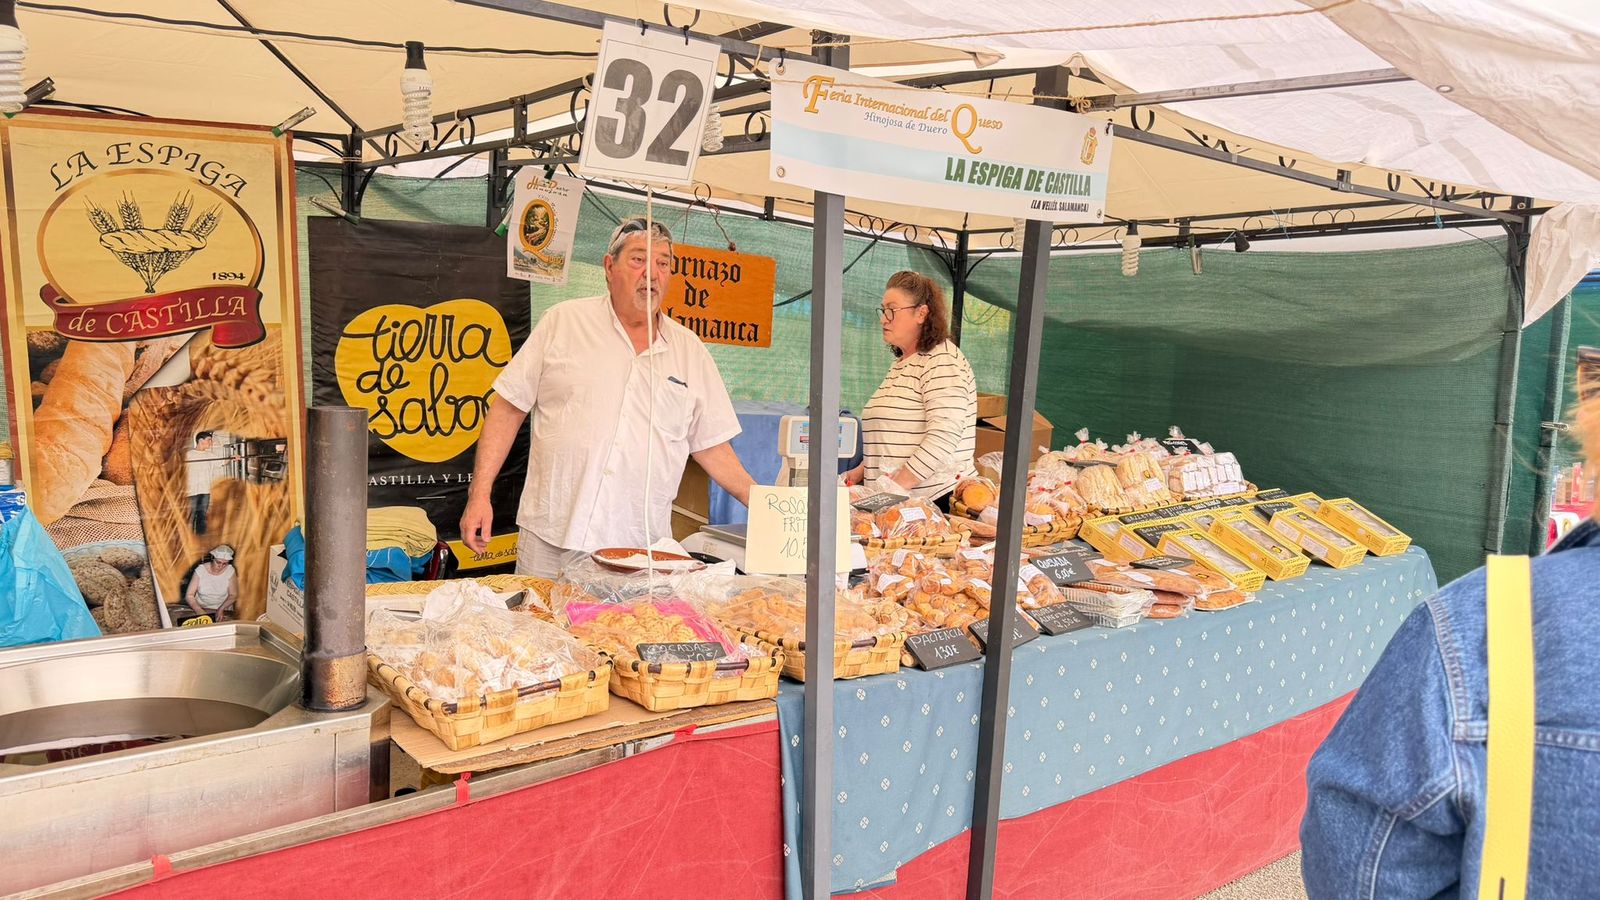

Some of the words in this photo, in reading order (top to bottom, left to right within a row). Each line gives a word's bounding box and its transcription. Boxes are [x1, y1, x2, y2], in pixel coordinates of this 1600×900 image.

[595, 58, 704, 167] 32
[802, 75, 853, 114] Feria
[851, 93, 929, 120] Internacional
[930, 108, 951, 123] del
[951, 103, 1004, 155] Queso
[864, 111, 904, 129] Hinojosa
[905, 119, 916, 131] de
[918, 122, 948, 135] Duero
[50, 150, 98, 192] LA
[106, 142, 248, 198] ESPIGA
[945, 157, 964, 183] LA
[968, 160, 1023, 191] ESPIGA
[1024, 168, 1044, 193] DE
[1045, 171, 1092, 197] CASTILLA
[212, 271, 246, 282] 1894
[671, 254, 741, 287] ornazo
[684, 279, 710, 308] de
[68, 308, 96, 333] de
[106, 295, 247, 334] CASTILLA
[667, 306, 759, 342] lamanca
[341, 314, 509, 368] tierra
[356, 362, 410, 394] de
[368, 474, 436, 486] ASTILLA
[442, 473, 451, 484] Y
[765, 493, 807, 516] ROSQ
[1036, 556, 1073, 569] QUESADA
[909, 627, 964, 649] PACIENCIA
